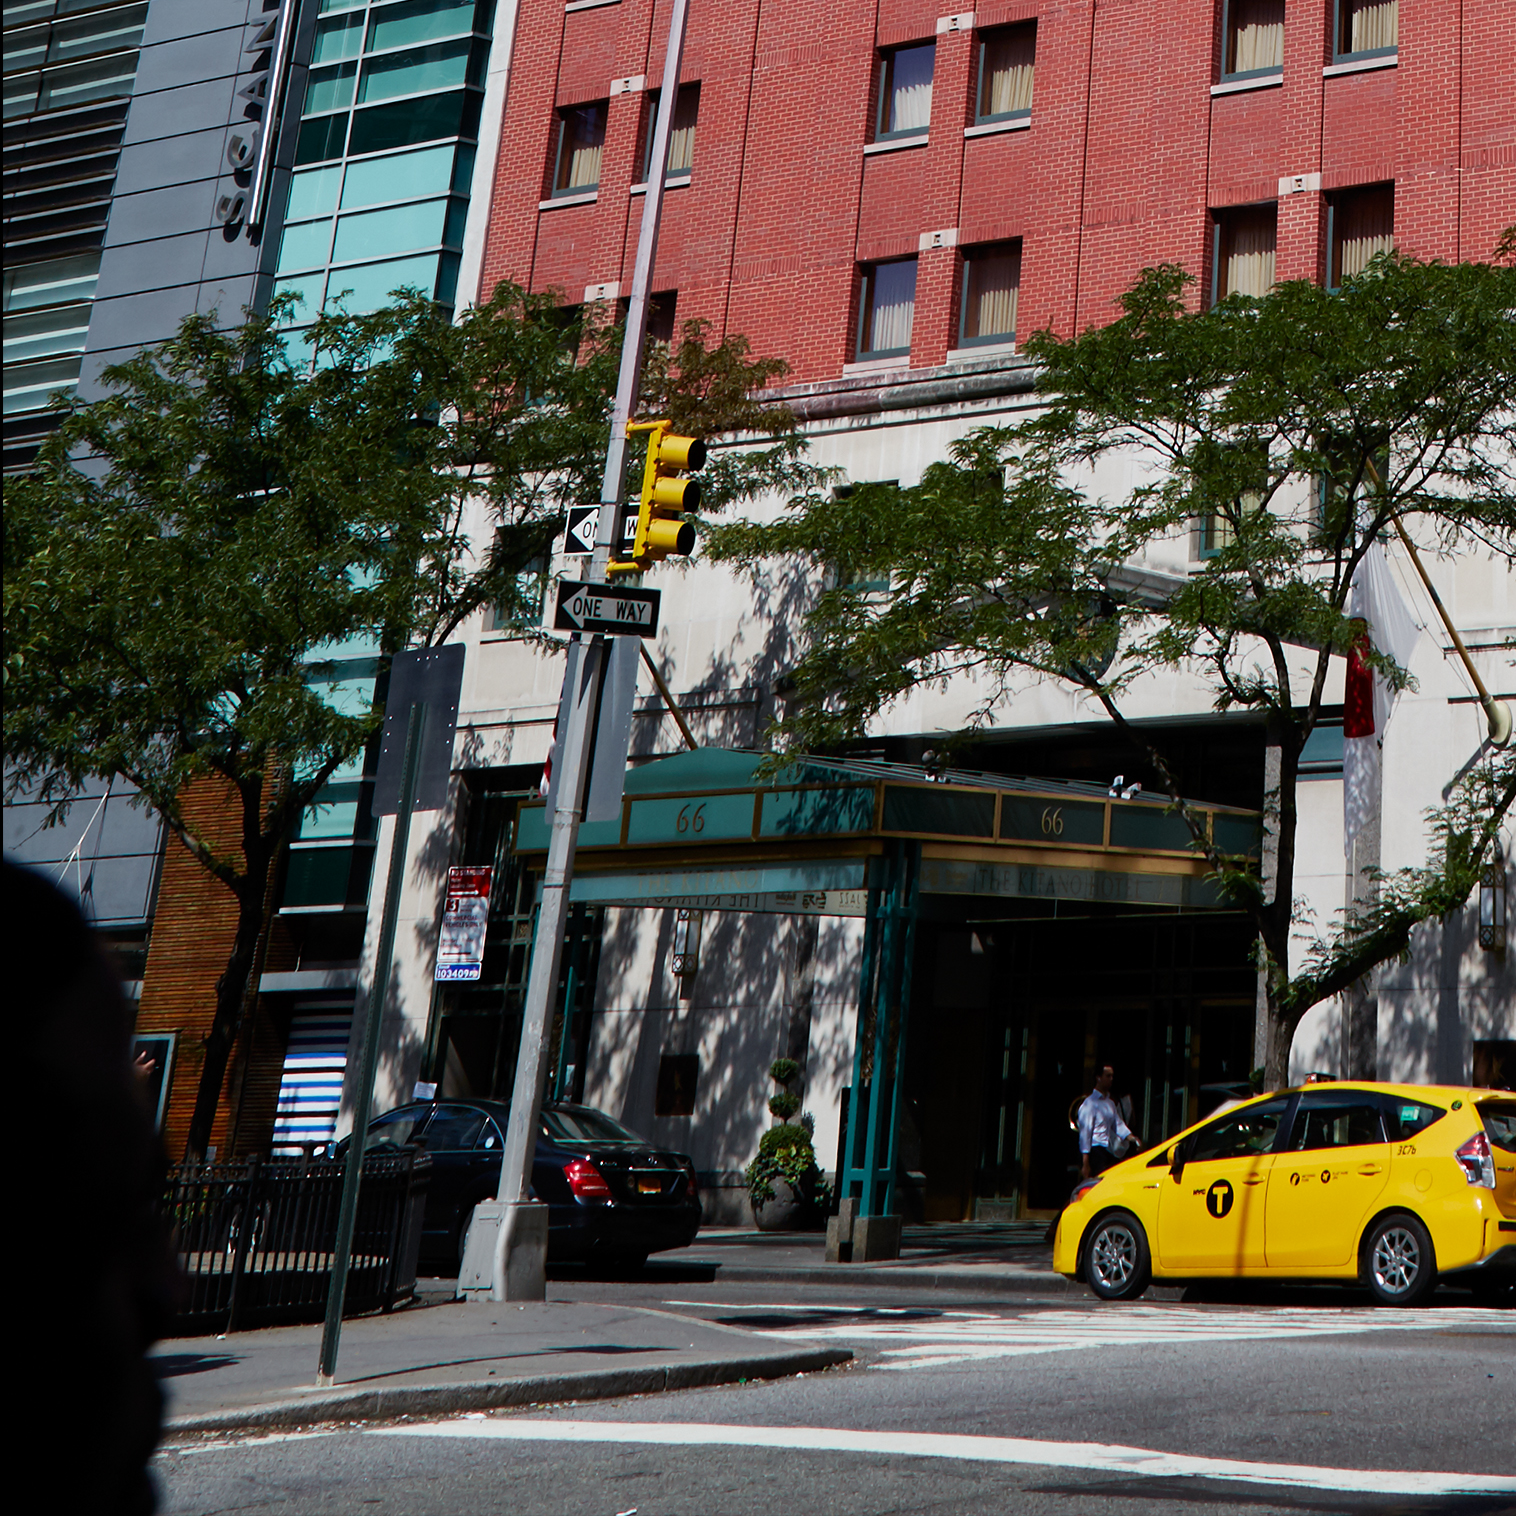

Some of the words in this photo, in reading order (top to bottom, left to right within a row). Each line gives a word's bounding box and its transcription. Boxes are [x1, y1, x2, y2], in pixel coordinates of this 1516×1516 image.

[573, 597, 602, 617] ONE
[617, 600, 647, 622] WAY
[676, 803, 707, 833] 66
[1041, 806, 1064, 836] 66
[637, 872, 671, 894] THE
[681, 867, 759, 893] KITANO
[980, 869, 1010, 892] THE
[1018, 871, 1082, 897] KITANO
[449, 899, 456, 911] 3
[1193, 1188, 1206, 1196] NYC
[1212, 1186, 1229, 1215] T
